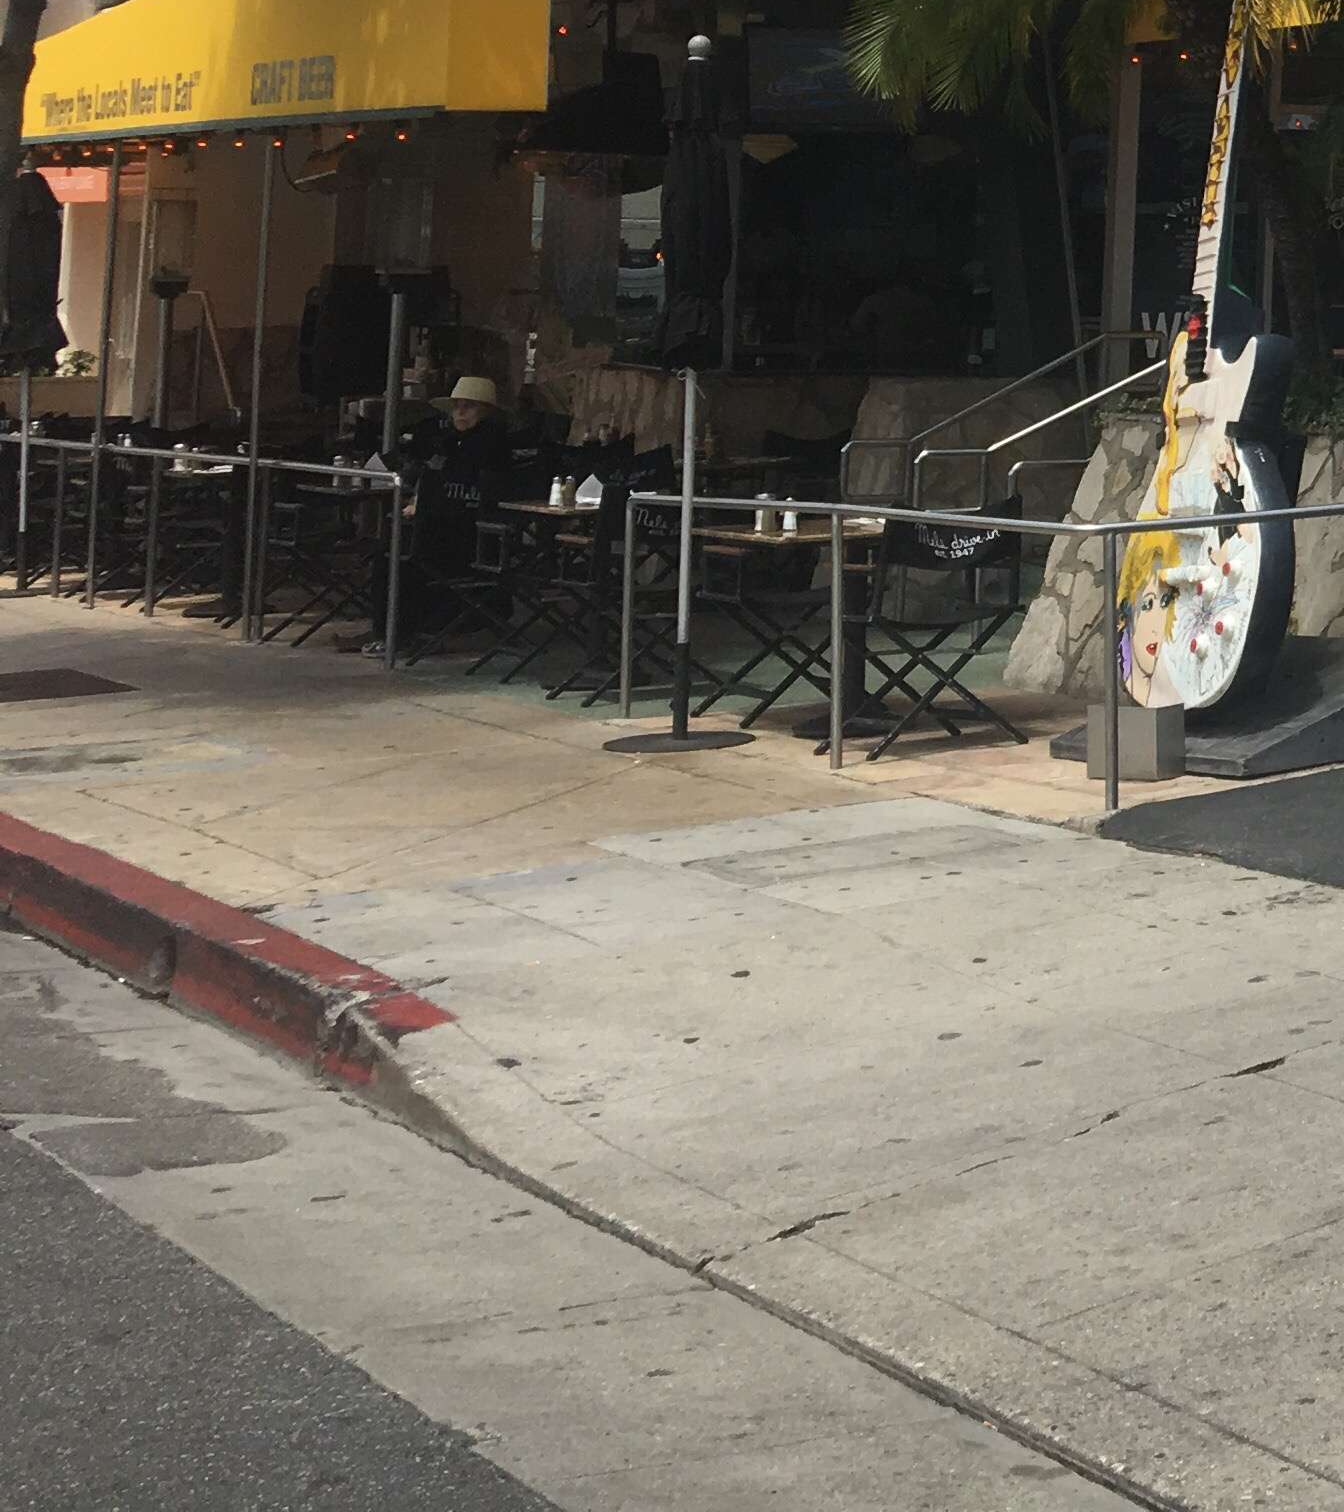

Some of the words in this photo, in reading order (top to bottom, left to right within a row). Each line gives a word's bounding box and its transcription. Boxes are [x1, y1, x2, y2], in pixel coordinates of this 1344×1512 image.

[76, 88, 92, 122] the
[95, 83, 128, 121] Locals
[130, 77, 158, 115] Meet
[160, 76, 172, 113] to
[251, 59, 296, 106] CRAFT
[297, 55, 337, 101] BEER
[950, 547, 975, 559] 1947
